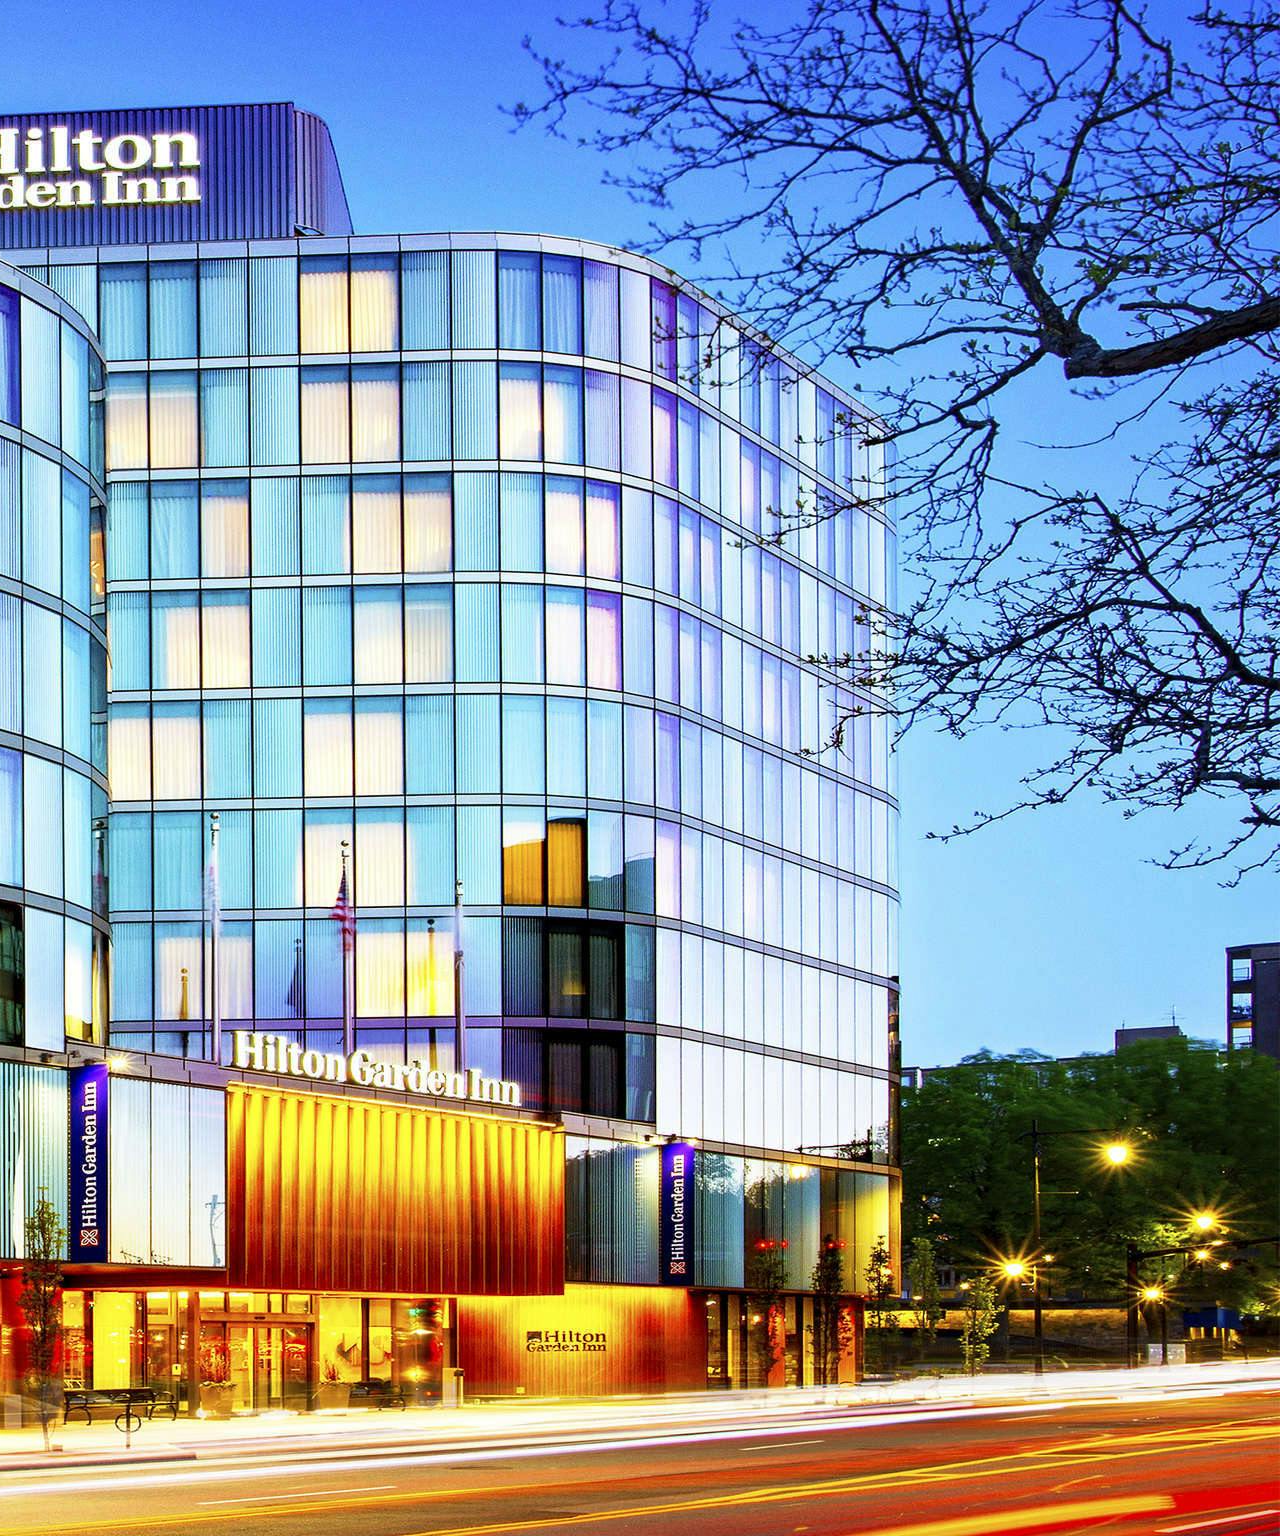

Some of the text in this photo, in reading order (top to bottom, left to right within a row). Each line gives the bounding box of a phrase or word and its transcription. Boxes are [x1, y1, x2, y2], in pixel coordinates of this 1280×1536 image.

[102, 171, 202, 205] Inn
[230, 1030, 521, 1106] Hilton Garden Inn
[81, 1081, 97, 1228] Hilton Garden Inn
[670, 1154, 685, 1260] Hilton Garden Inn
[526, 1342, 607, 1352] Garden Inn
[544, 1330, 607, 1342] Hilton
